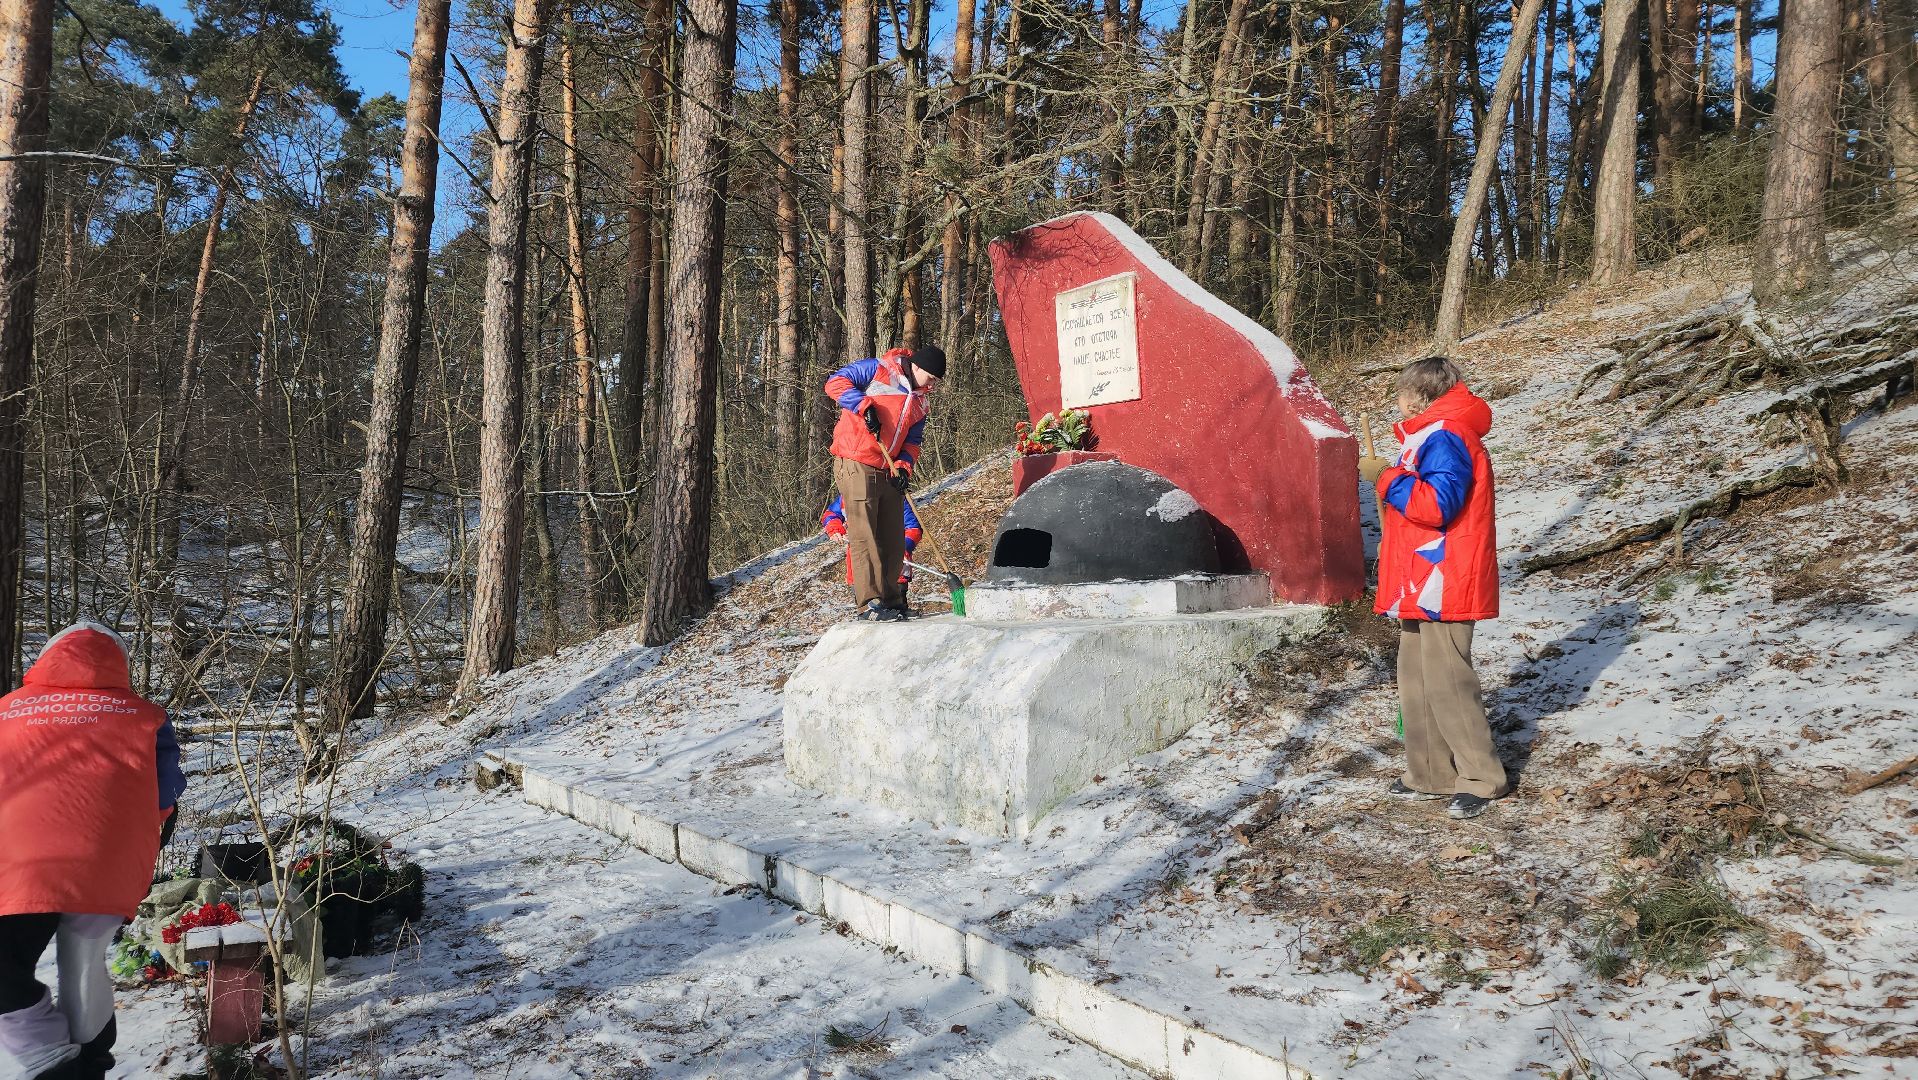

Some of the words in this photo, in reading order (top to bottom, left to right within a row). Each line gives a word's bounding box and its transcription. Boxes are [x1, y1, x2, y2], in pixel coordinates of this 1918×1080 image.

[1074, 336, 1085, 347] КТО
[1094, 348, 1121, 363] СЧАСТЬЕ
[9, 693, 126, 708] ВОЛОНТЕРЫ
[27, 717, 48, 726] МЫ
[53, 715, 98, 725] РЯДОМ
